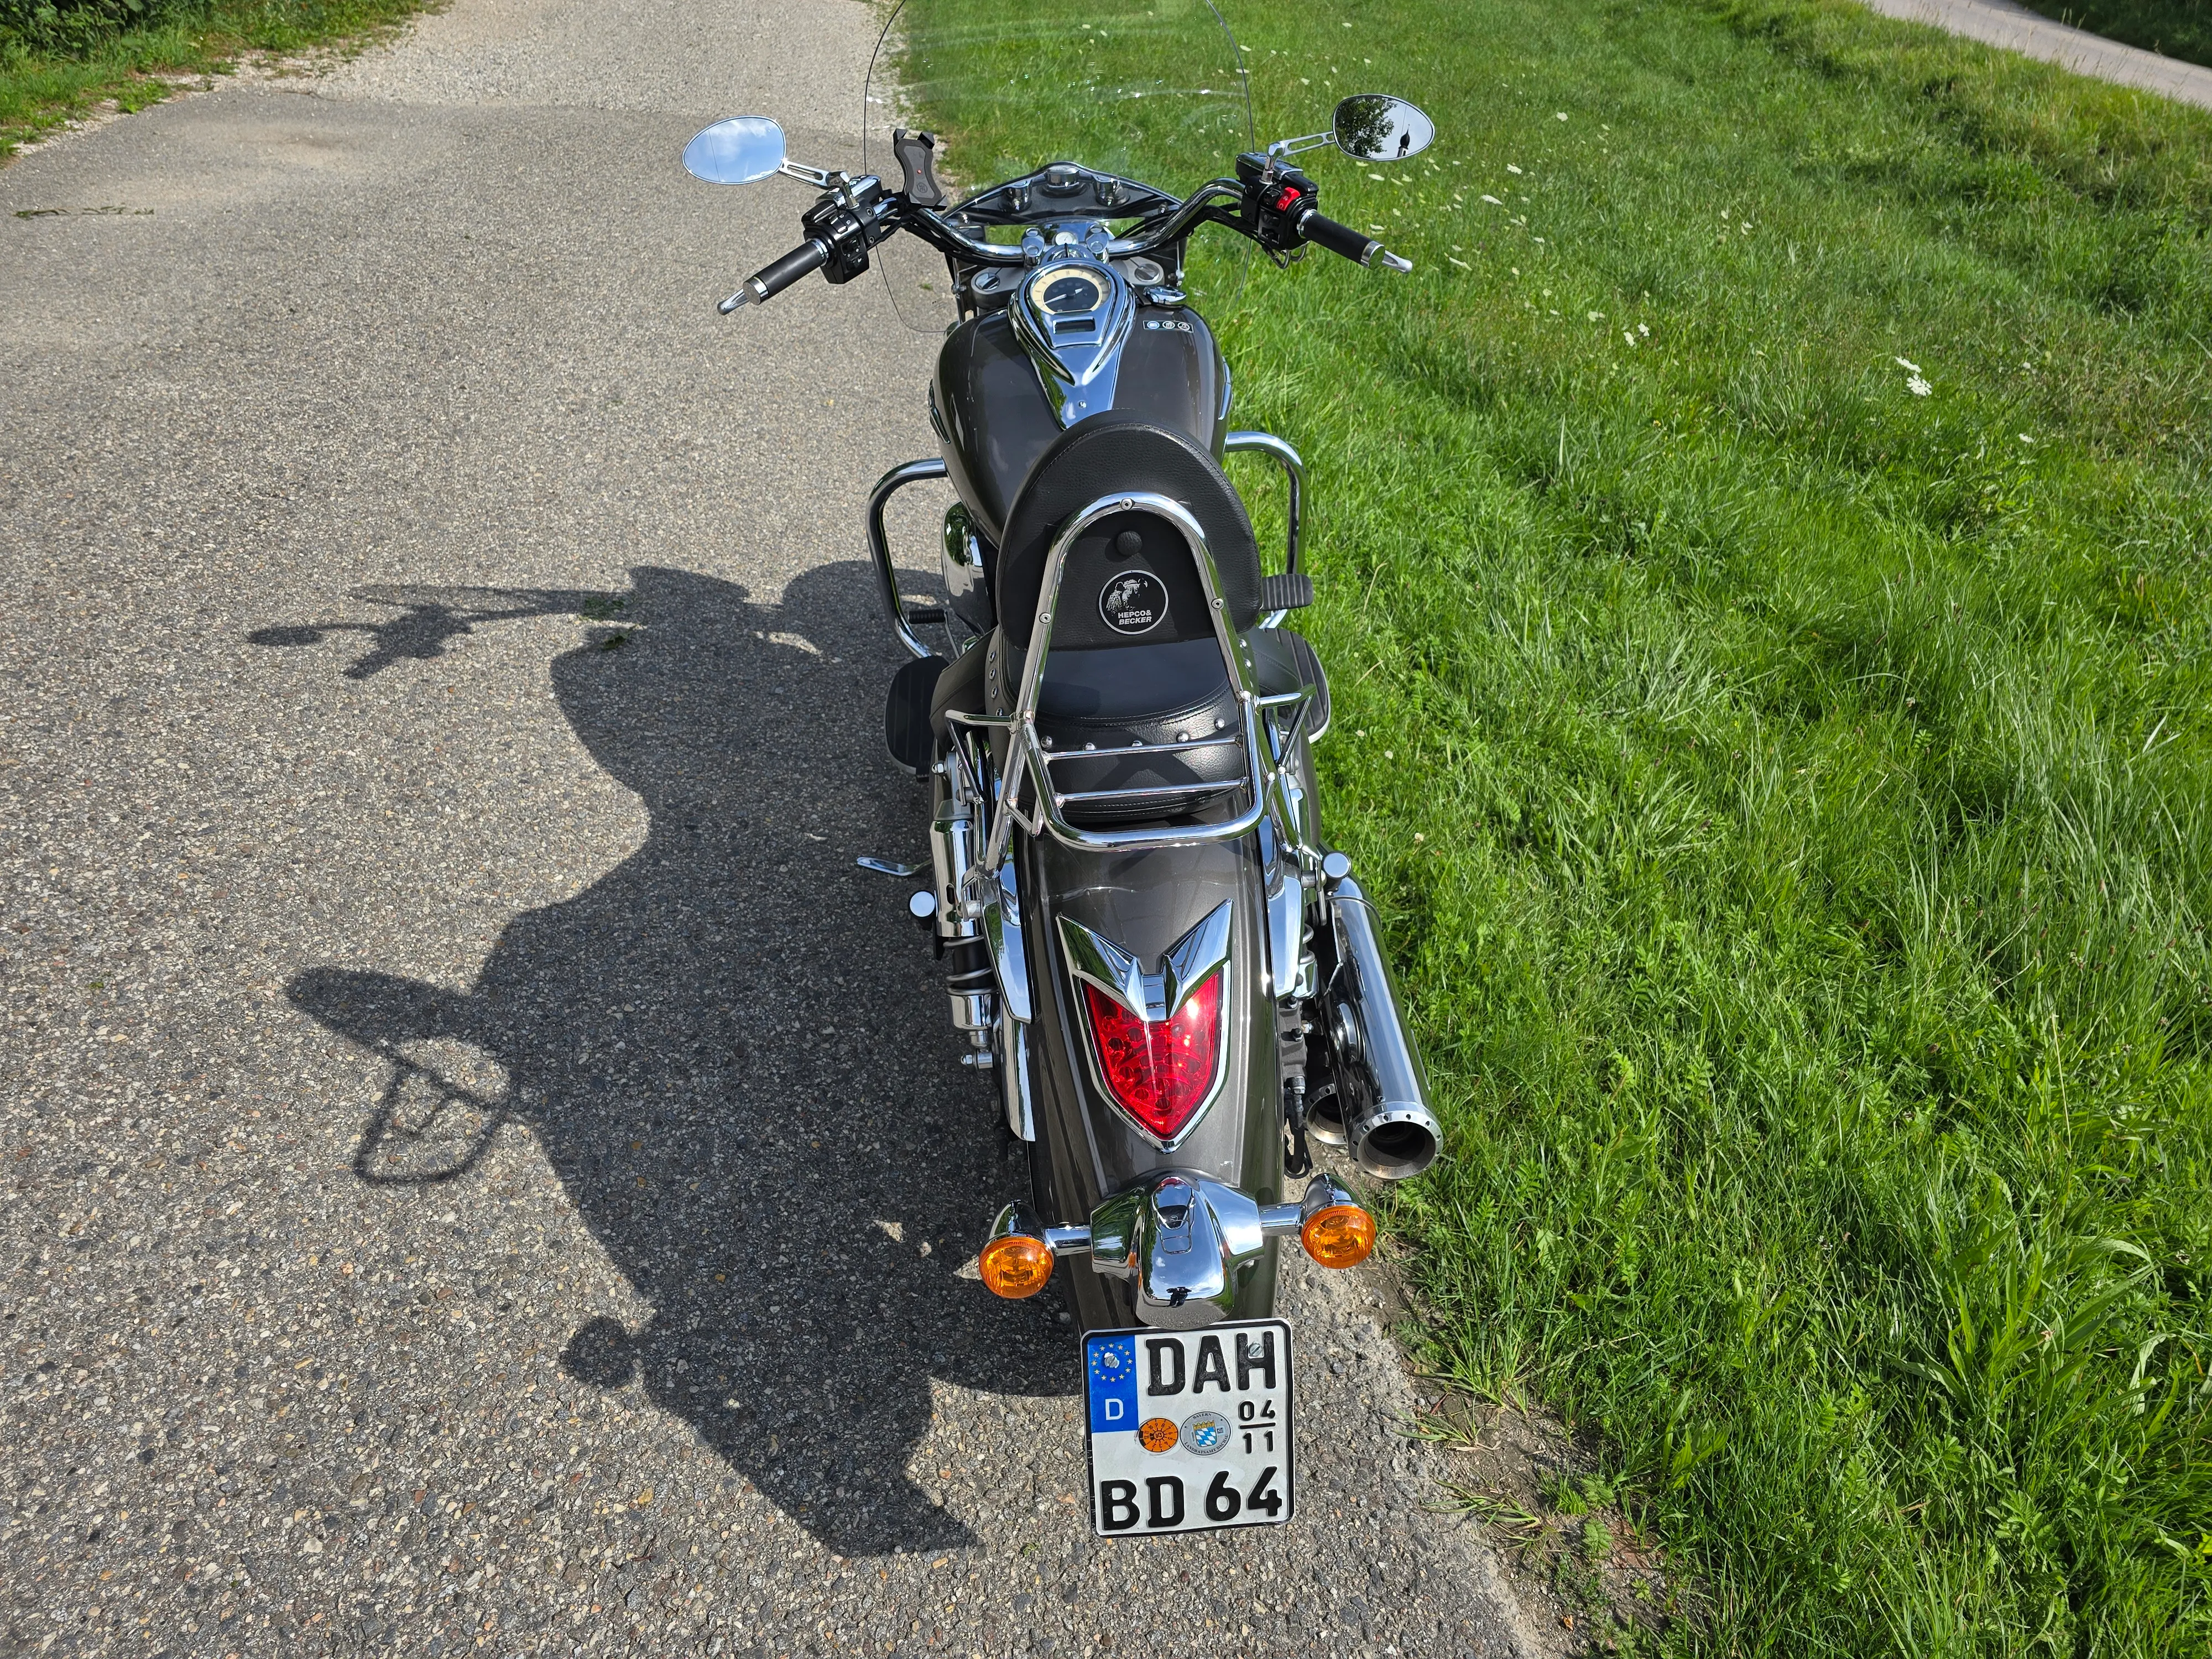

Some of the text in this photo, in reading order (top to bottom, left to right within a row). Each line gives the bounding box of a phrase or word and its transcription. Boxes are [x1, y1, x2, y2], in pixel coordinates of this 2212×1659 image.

[1118, 610, 1152, 618] HEPCO&
[1119, 617, 1152, 625] BECKER
[1145, 1331, 1276, 1396] DAH
[1105, 1399, 1124, 1421] D
[1239, 1400, 1276, 1421] 04
[1185, 1434, 1229, 1454] LANDRATSAMT DACHAU
[1242, 1431, 1274, 1454] 11
[1100, 1467, 1282, 1530] BD 64
